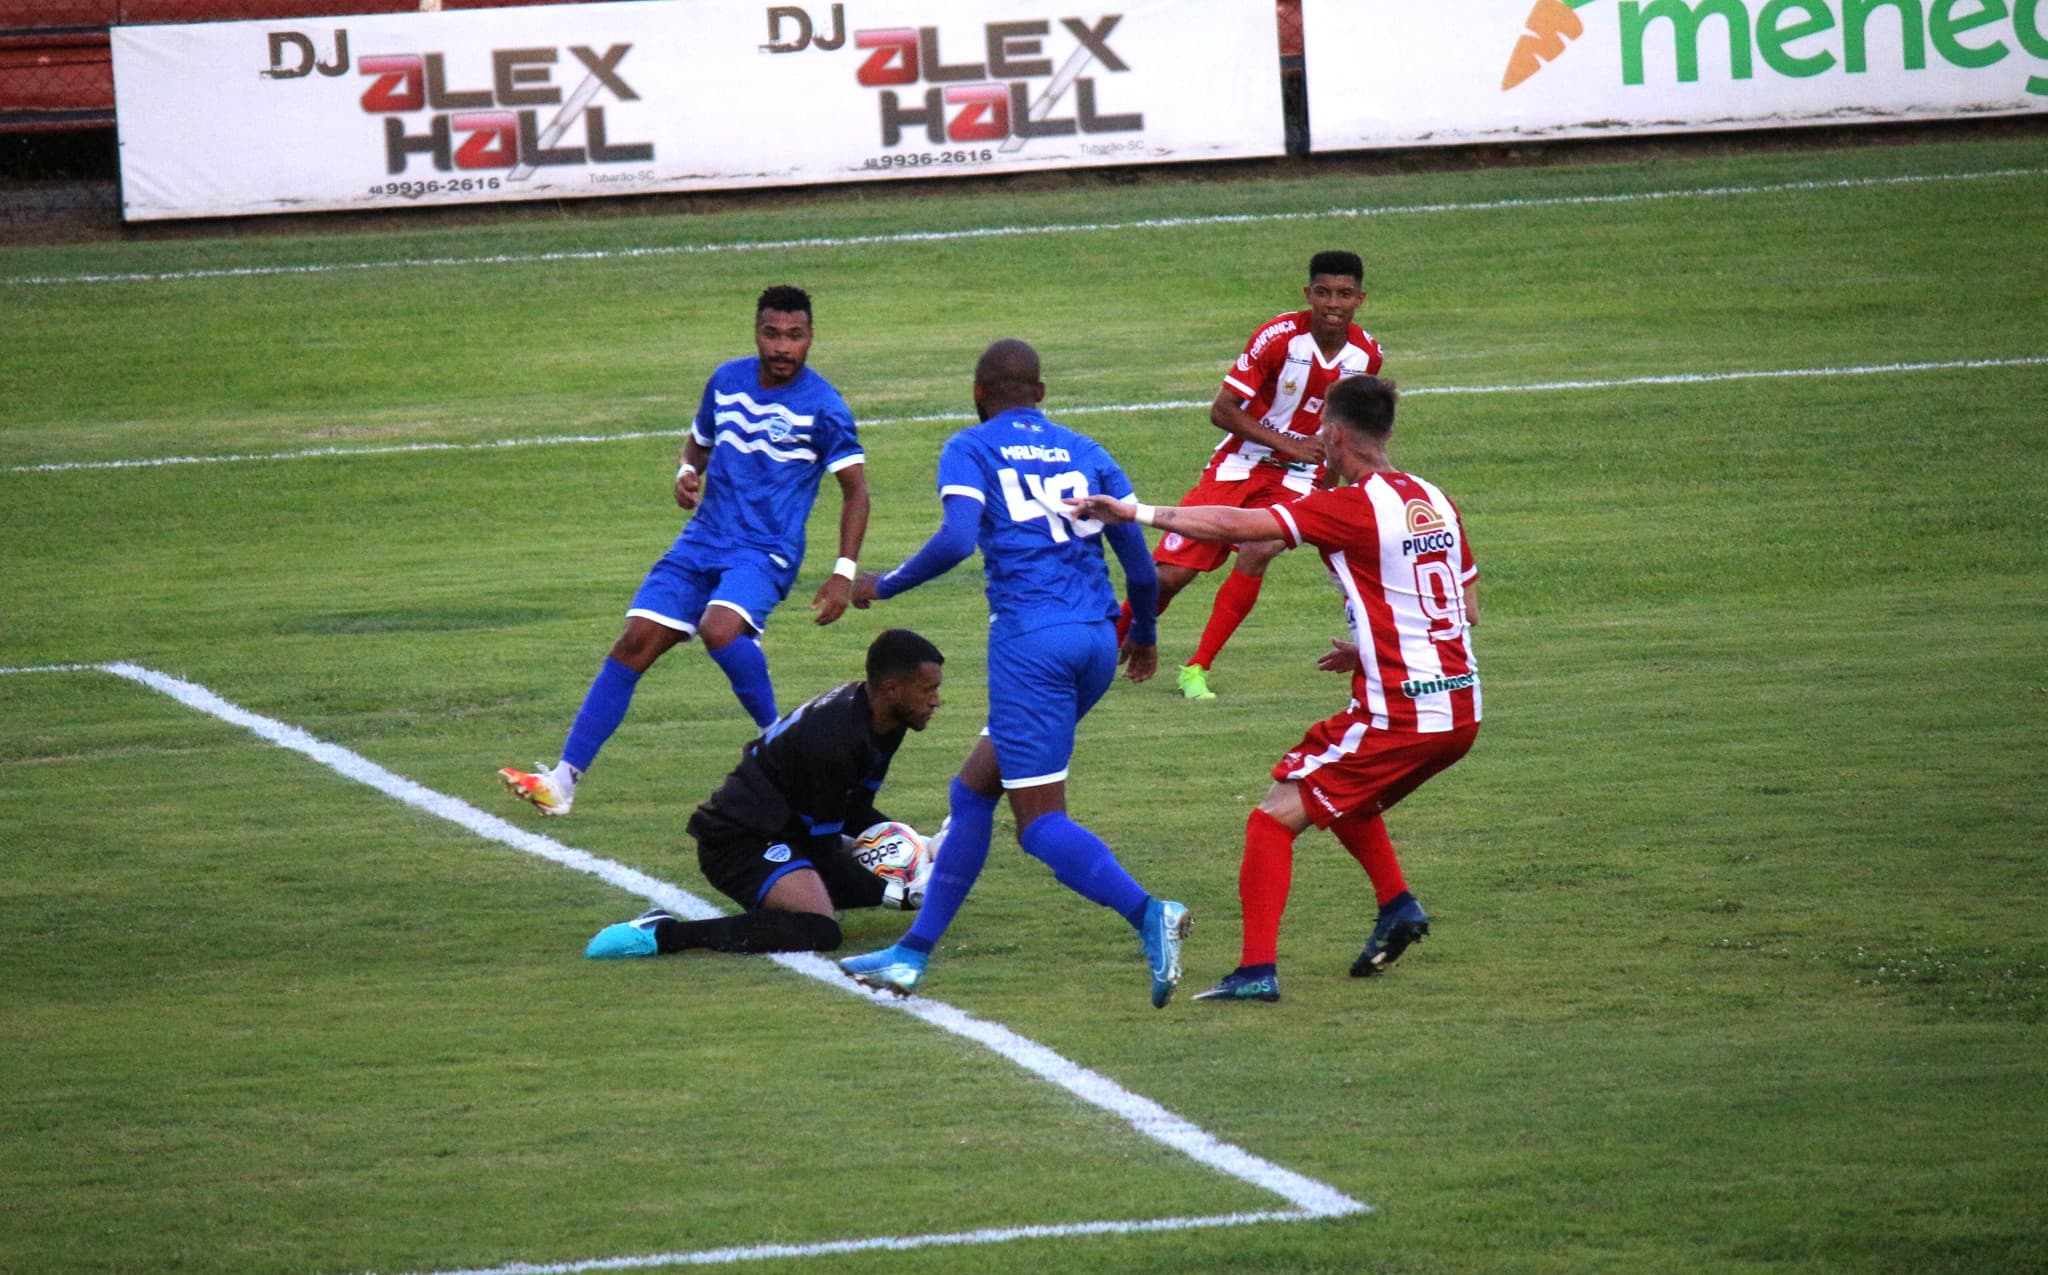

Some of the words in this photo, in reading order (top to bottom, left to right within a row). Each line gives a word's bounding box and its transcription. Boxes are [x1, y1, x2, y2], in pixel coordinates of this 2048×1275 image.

[759, 3, 845, 53] DJ
[259, 29, 349, 79] DJ
[880, 149, 992, 167] 9936-2616
[386, 177, 500, 196] 9936-2616
[1402, 532, 1455, 556] PIUCCO
[1412, 559, 1464, 642] 9
